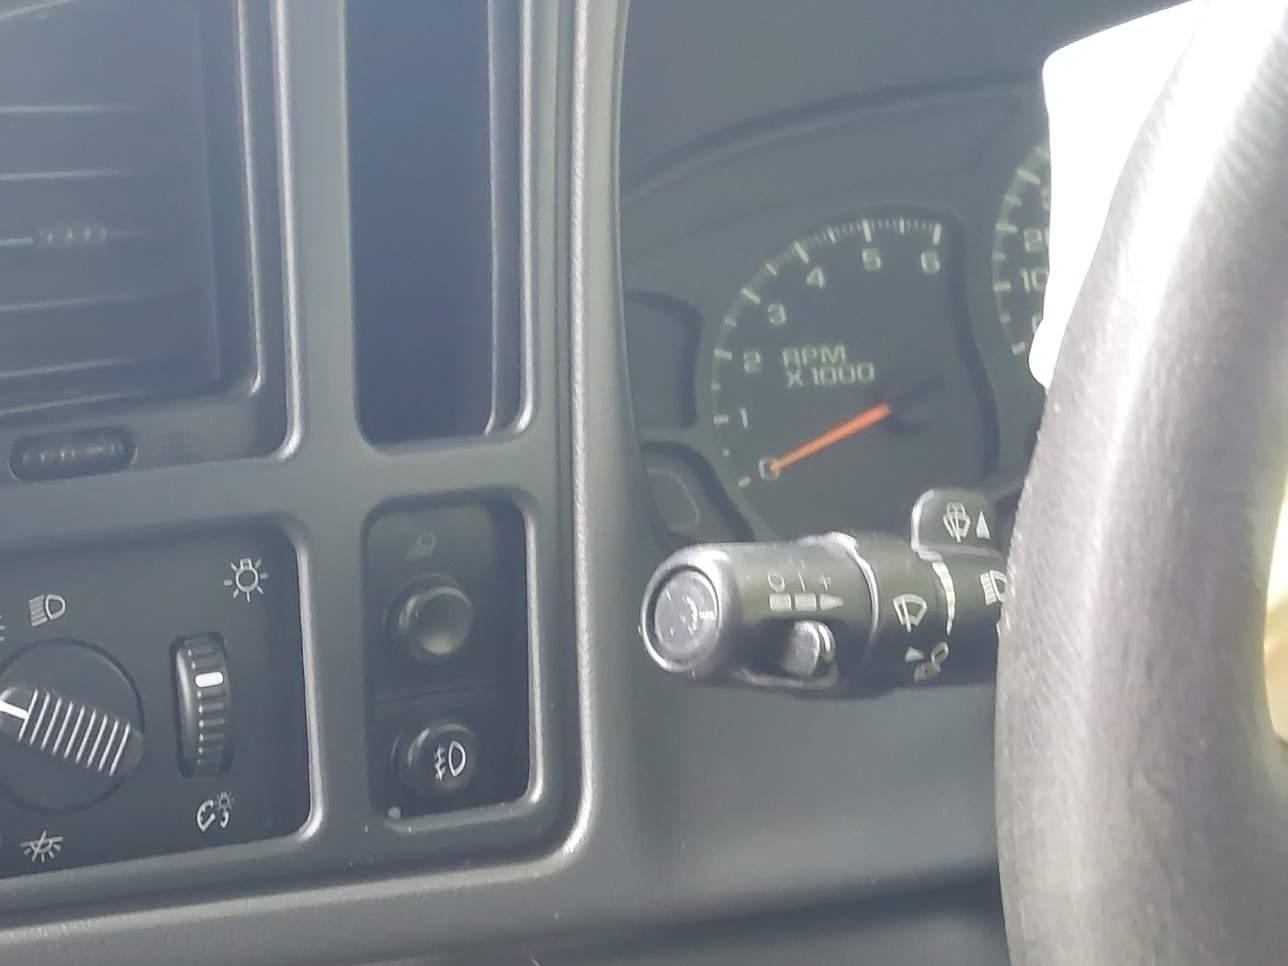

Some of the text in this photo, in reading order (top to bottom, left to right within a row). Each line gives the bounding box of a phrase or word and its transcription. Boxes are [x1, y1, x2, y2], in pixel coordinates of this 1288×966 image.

[862, 248, 881, 271] 5
[920, 249, 941, 273] 6
[806, 265, 826, 288] 4
[767, 303, 786, 325] 3
[743, 350, 762, 373] 2
[782, 344, 847, 368] RPM
[739, 406, 749, 428] 1
